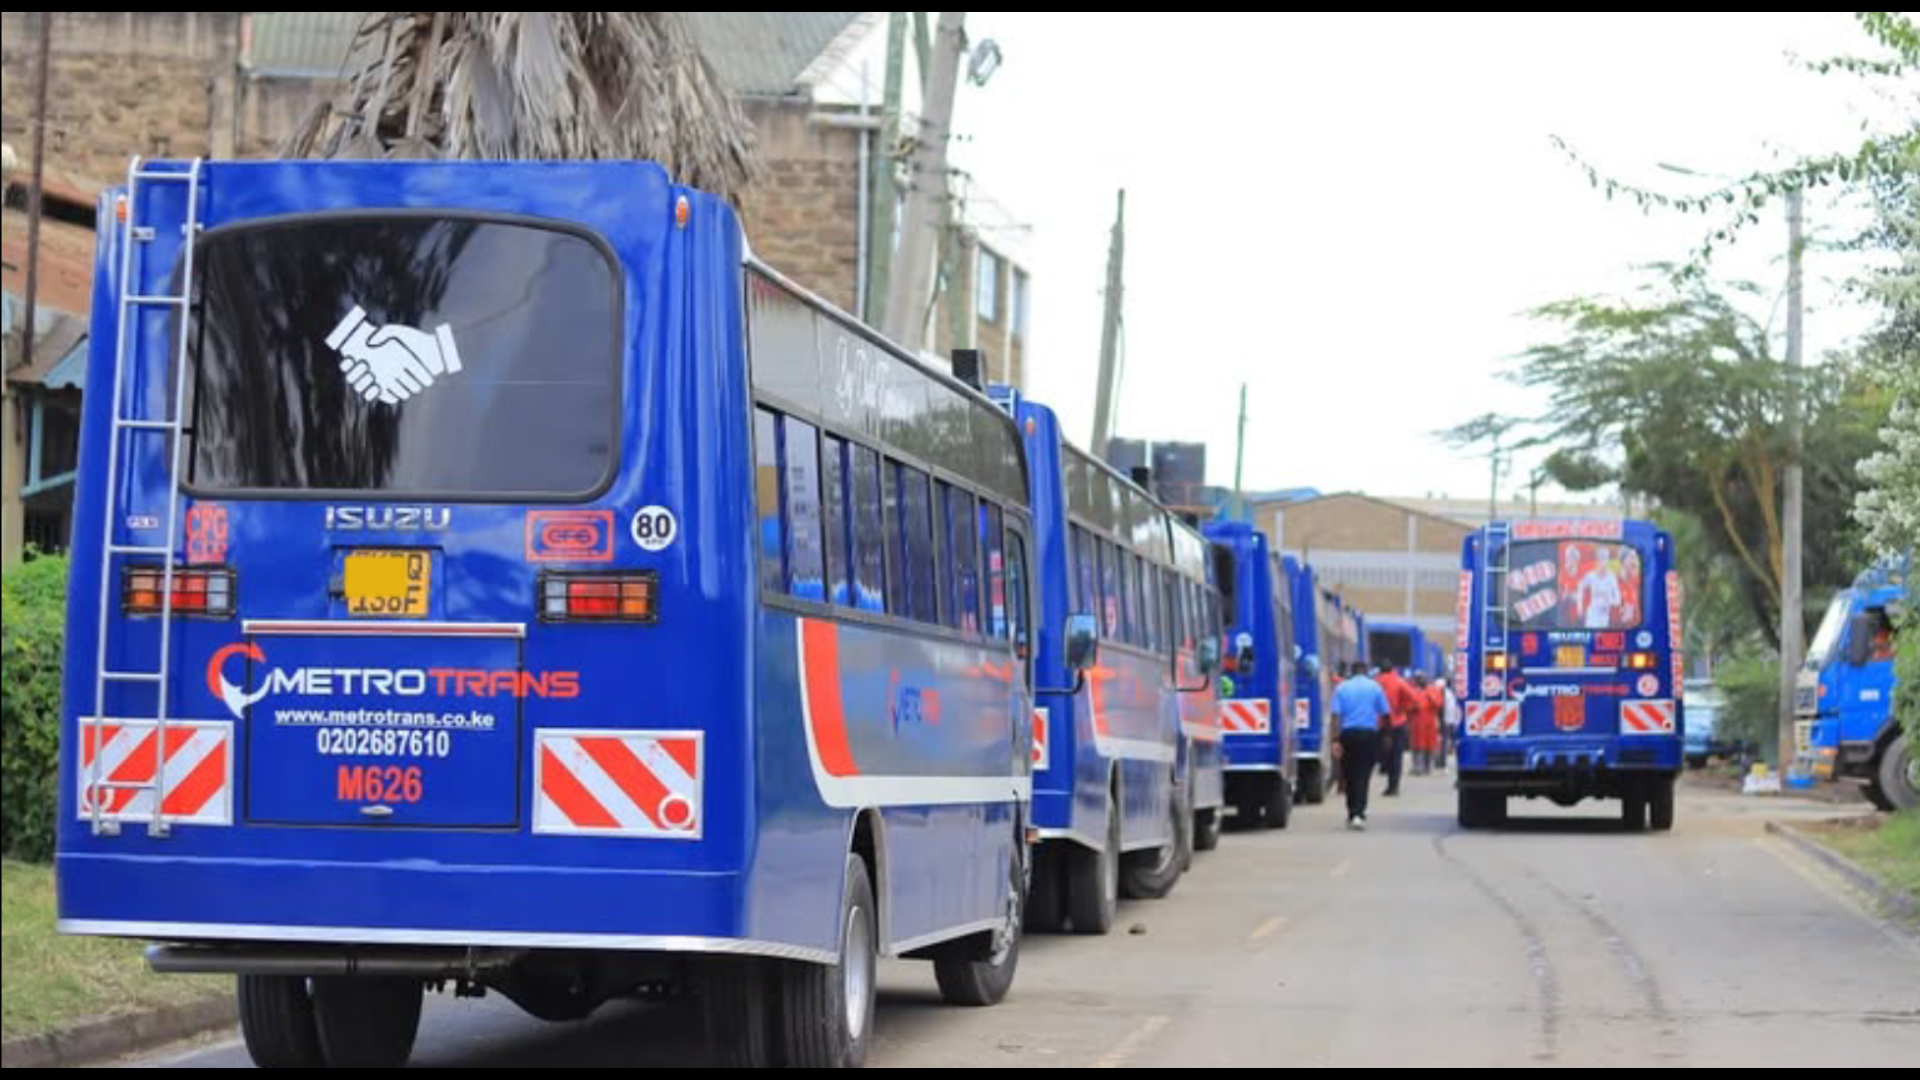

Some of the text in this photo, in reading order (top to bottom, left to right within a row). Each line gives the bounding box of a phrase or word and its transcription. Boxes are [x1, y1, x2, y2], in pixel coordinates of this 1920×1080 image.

[325, 506, 450, 530] ISUZU
[637, 513, 671, 538] 80
[273, 667, 579, 697] METROTRANS
[275, 708, 495, 730] www.metrotrans.co.ke
[317, 728, 450, 757] 0202687610
[337, 764, 422, 803] M626
